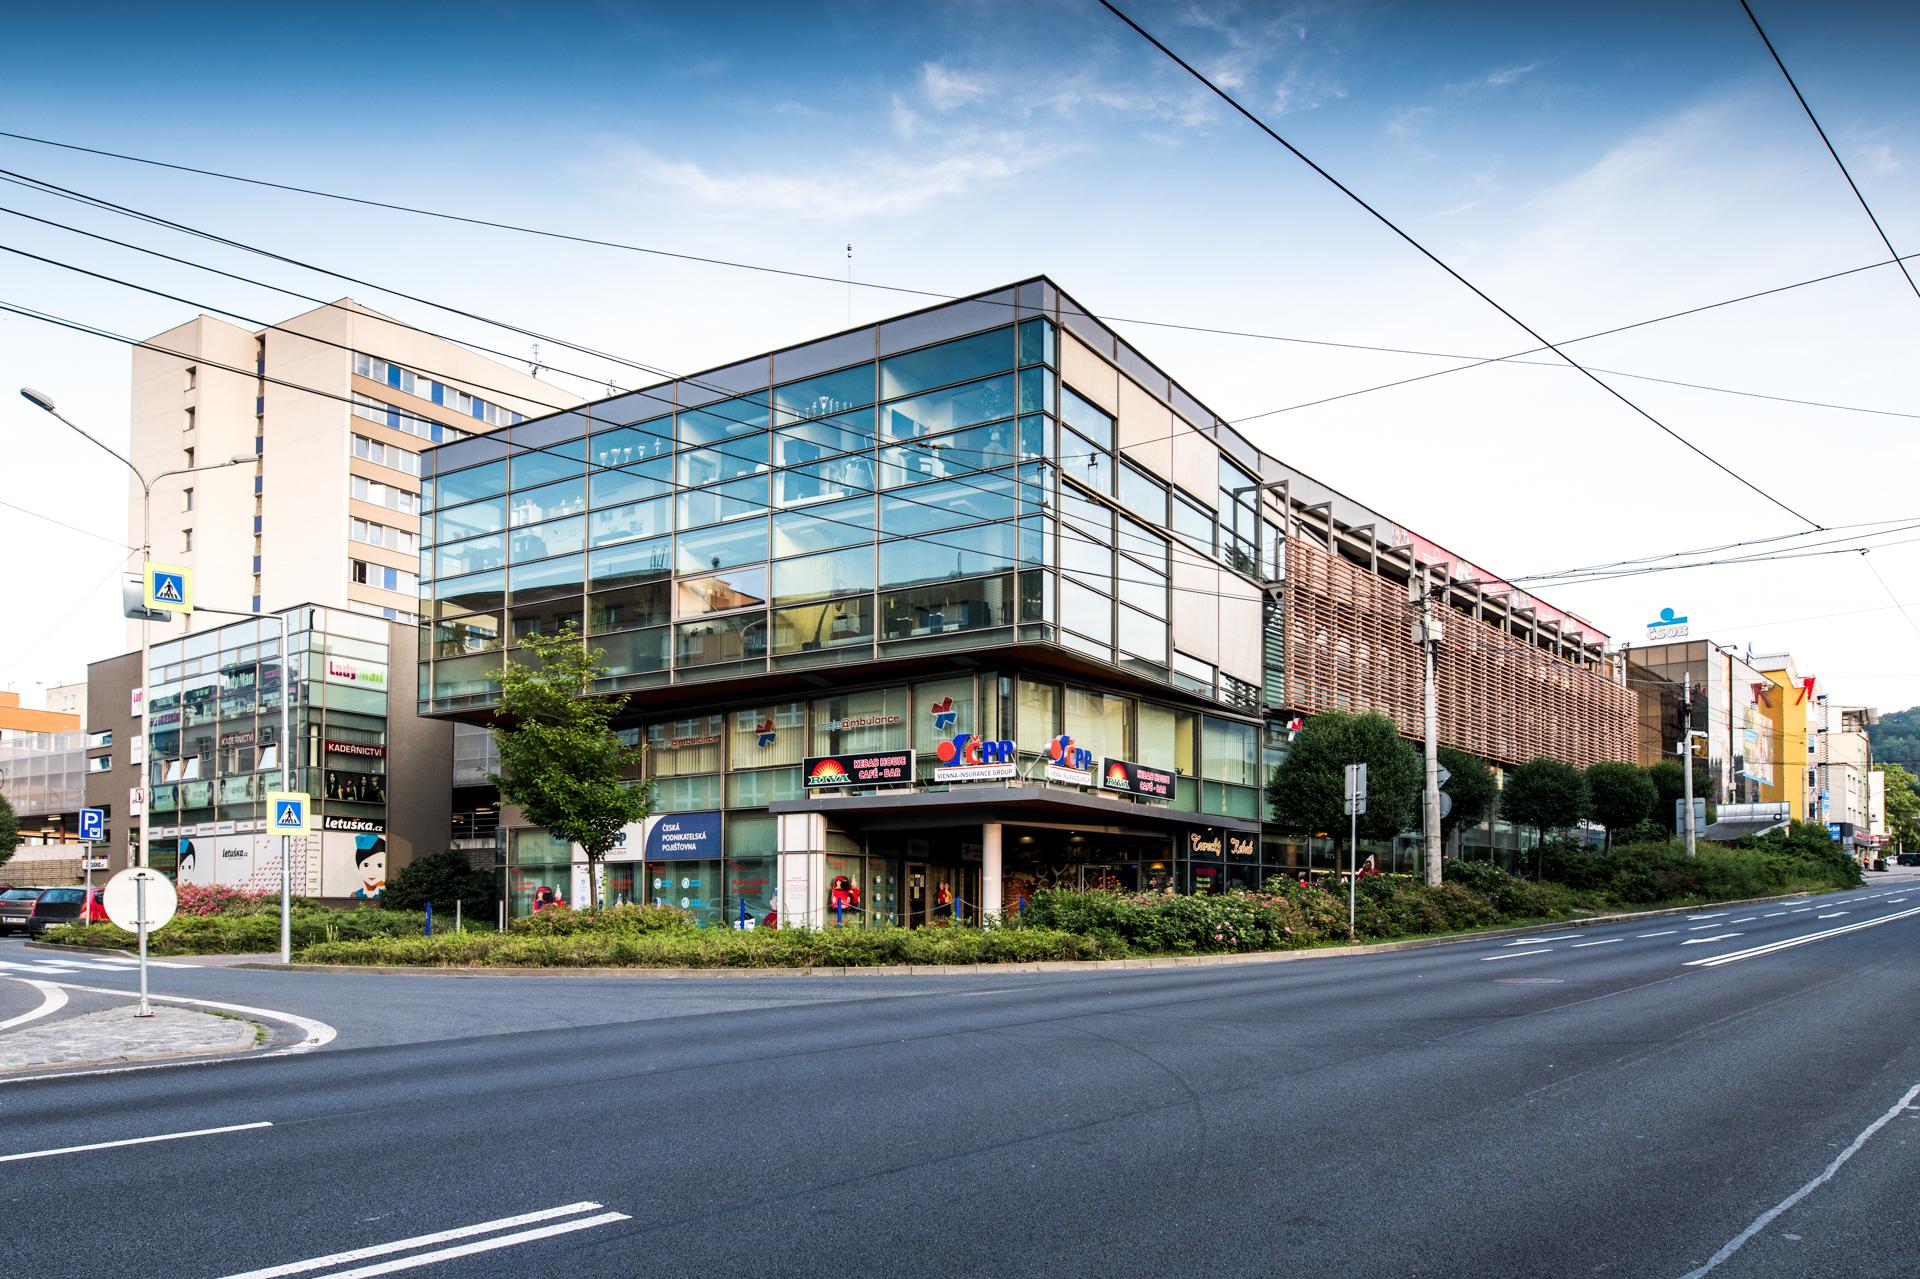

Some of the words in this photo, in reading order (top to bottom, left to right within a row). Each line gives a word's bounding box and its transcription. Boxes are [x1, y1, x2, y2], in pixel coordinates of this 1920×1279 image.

[328, 743, 382, 757] KADEŘNICTVÍ
[854, 757, 879, 768] KEBAB
[881, 755, 906, 767] HOUSE
[859, 767, 878, 779] CAFÉ
[884, 767, 901, 778] BAR
[959, 770, 991, 778] INSURANCE
[993, 768, 1013, 776] GROUP
[808, 774, 851, 785] RIVA
[84, 813, 99, 830] P
[325, 817, 383, 832] letuška.cz
[662, 822, 680, 832] ČESKÁ
[662, 831, 707, 841] PODNIKATELSKÁ
[662, 841, 697, 852] POJIŠŤOVNA
